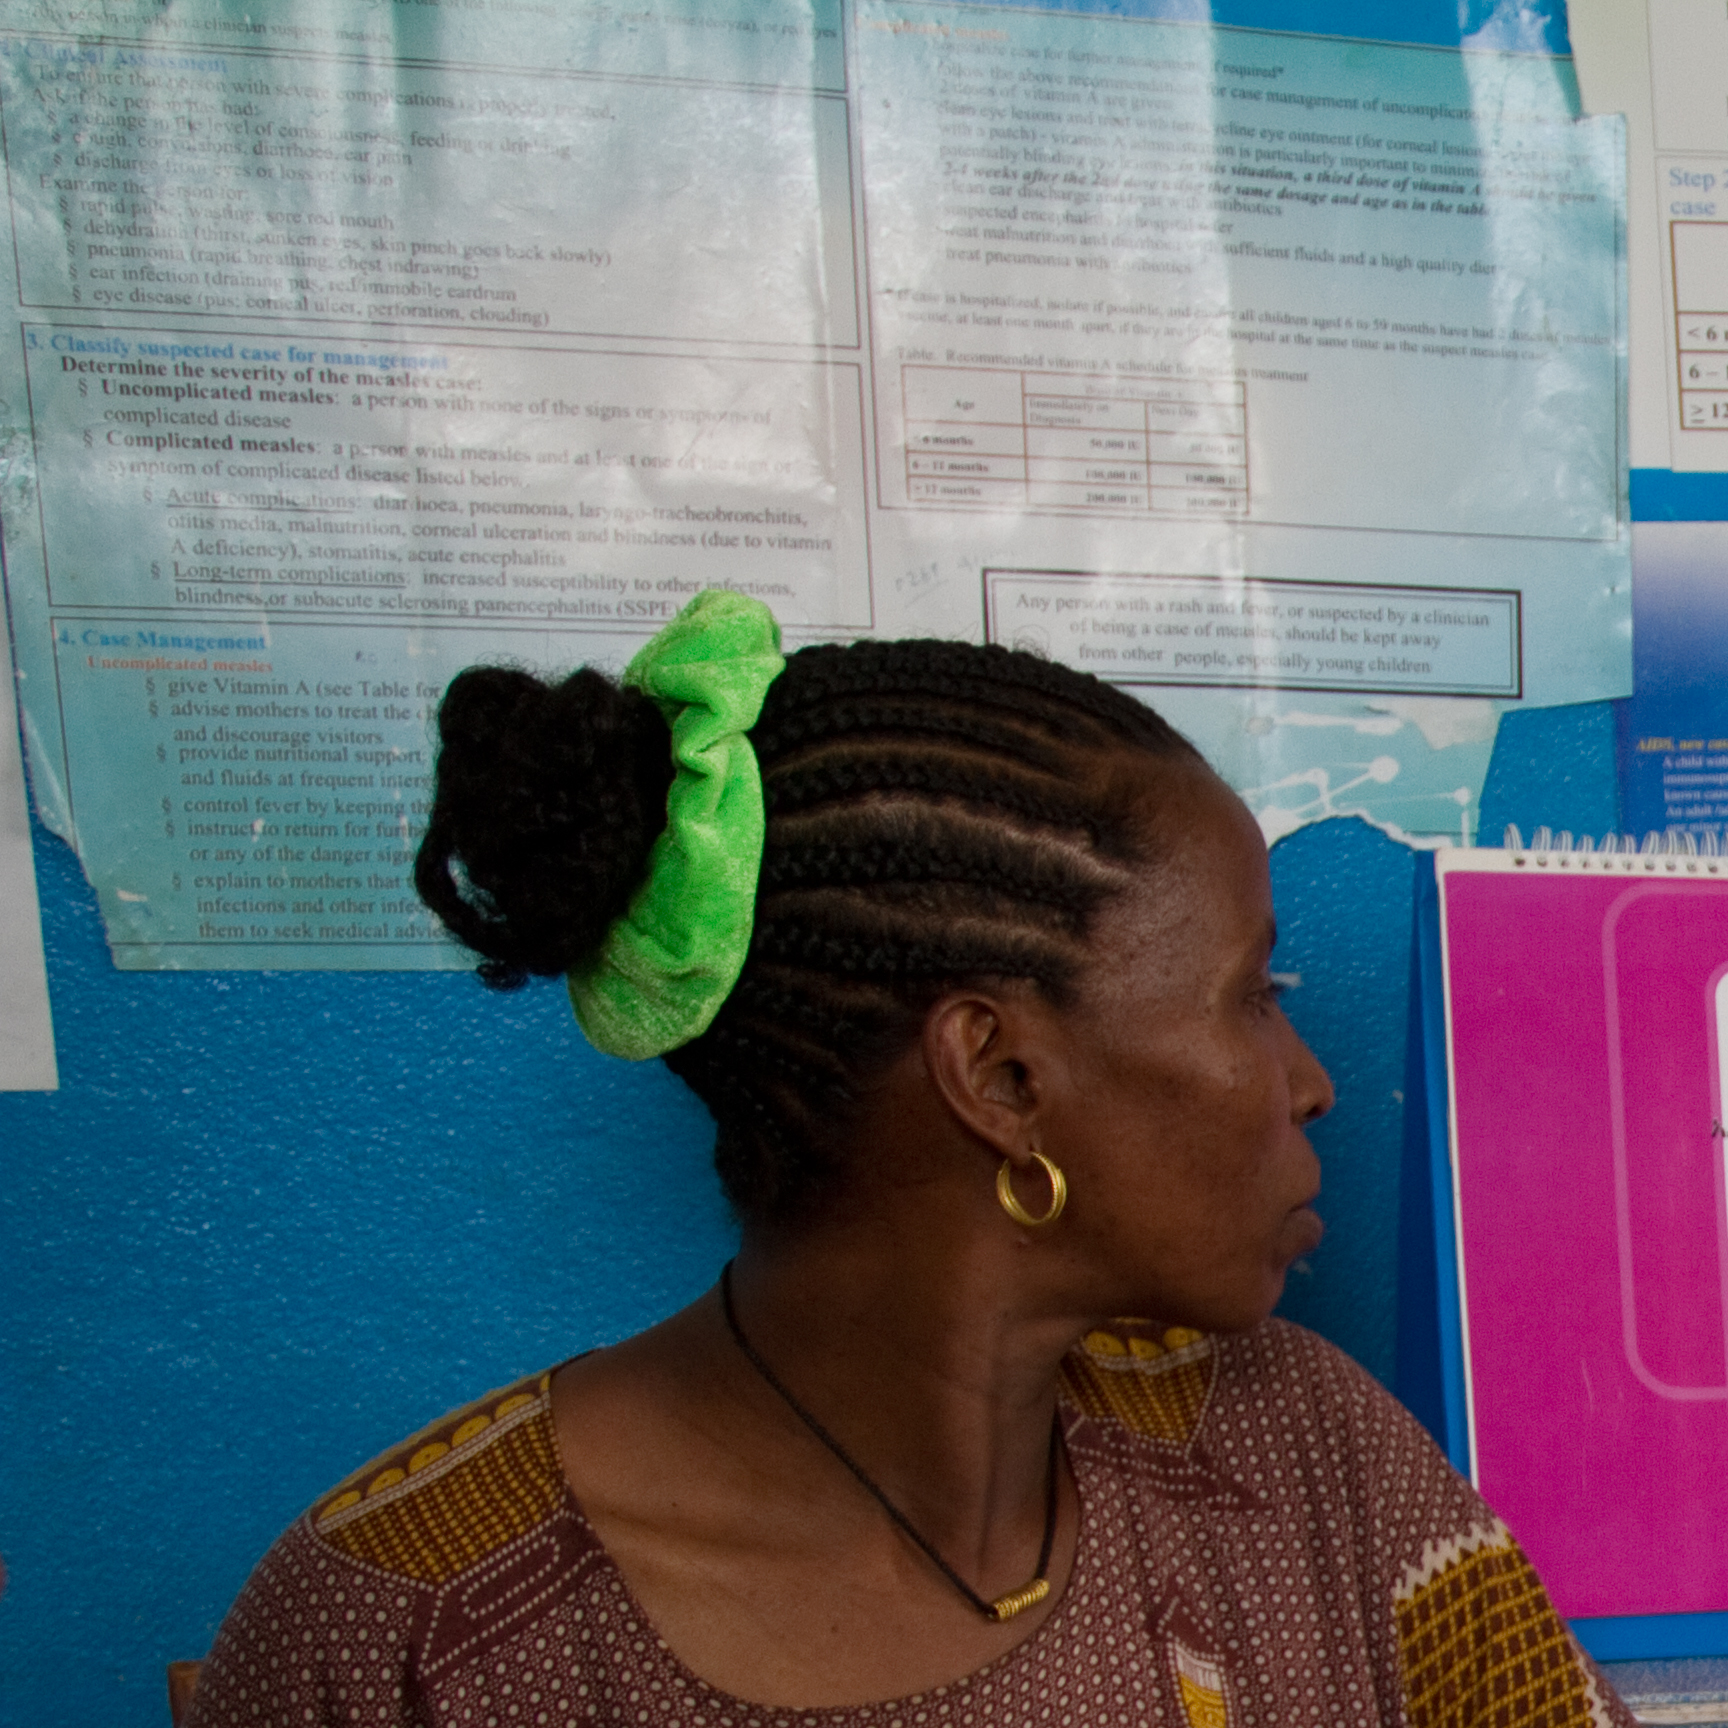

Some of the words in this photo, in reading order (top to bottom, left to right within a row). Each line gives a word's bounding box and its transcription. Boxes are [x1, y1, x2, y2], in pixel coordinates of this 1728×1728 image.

[1669, 168, 1716, 192] Step
[1669, 202, 1715, 216] case
[1705, 327, 1718, 341] 6
[50, 334, 129, 355] Classify
[137, 343, 234, 364] suspected
[239, 348, 280, 362] case
[287, 345, 314, 364] for
[322, 352, 446, 370] management
[1688, 365, 1701, 379] 6
[80, 629, 129, 647] Case
[137, 632, 266, 652] Management
[168, 680, 207, 702] give
[213, 677, 289, 696] Vitamin
[295, 680, 310, 696] A
[315, 682, 352, 699] (see
[361, 681, 410, 699] Table
